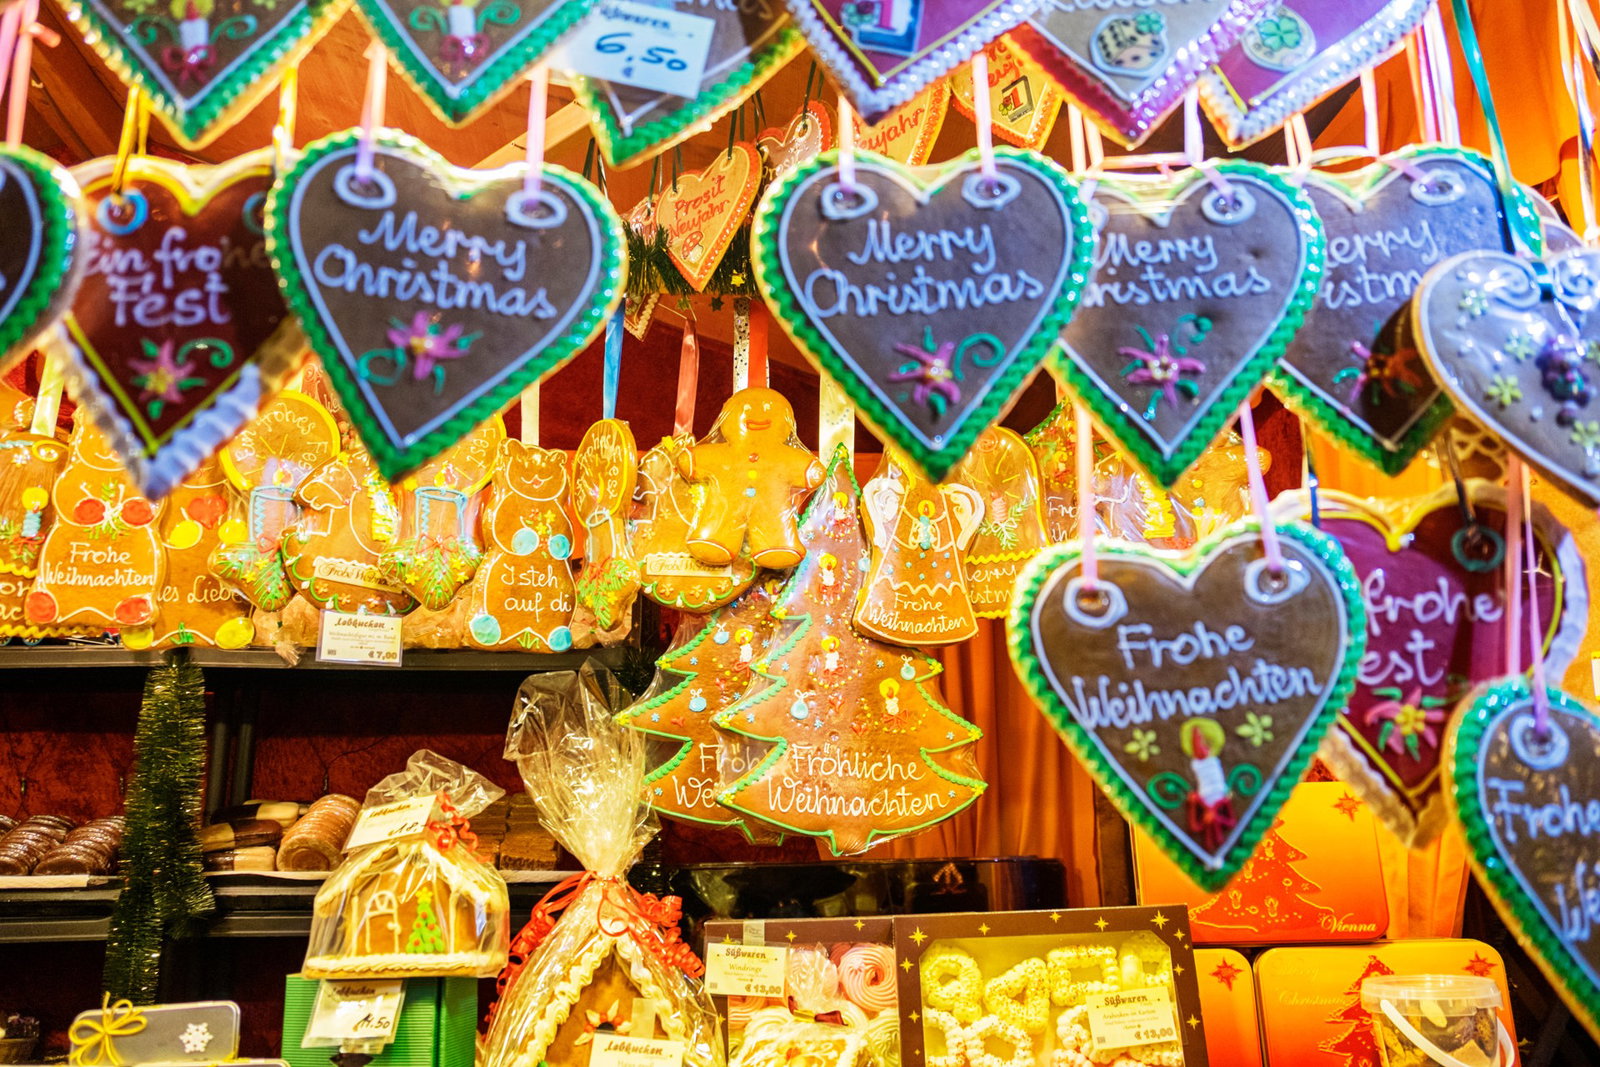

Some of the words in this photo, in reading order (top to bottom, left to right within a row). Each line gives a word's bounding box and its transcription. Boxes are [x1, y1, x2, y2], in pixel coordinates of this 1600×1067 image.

[674, 174, 726, 221] Prosit
[667, 198, 731, 242] Neujahr
[357, 211, 527, 281] Merry
[847, 218, 997, 274] Merry
[1094, 232, 1219, 272] Merry
[1325, 219, 1440, 265] erry
[105, 271, 231, 327] Fest
[313, 243, 557, 319] Christmas
[804, 265, 1044, 318] Christmas
[1083, 265, 1272, 306] ristmas
[70, 542, 133, 564] Frohe
[45, 562, 155, 587] Weihnachten
[504, 592, 545, 622] auf
[550, 594, 572, 613] di
[869, 604, 969, 634] Weihnachten
[894, 592, 945, 612] Frohe
[376, 650, 398, 660] 7,00
[1116, 621, 1255, 669] Frohe
[1358, 628, 1445, 685] est
[1071, 659, 1322, 729] Weihnachten
[791, 742, 926, 782] Fröhliche
[768, 775, 950, 817] Weihnachten
[1319, 912, 1377, 934] Vienna
[725, 947, 766, 959] Süßwaren
[754, 984, 782, 995] 13,00
[1104, 994, 1148, 1008] Süßwaren
[1143, 1027, 1174, 1040] 13,00
